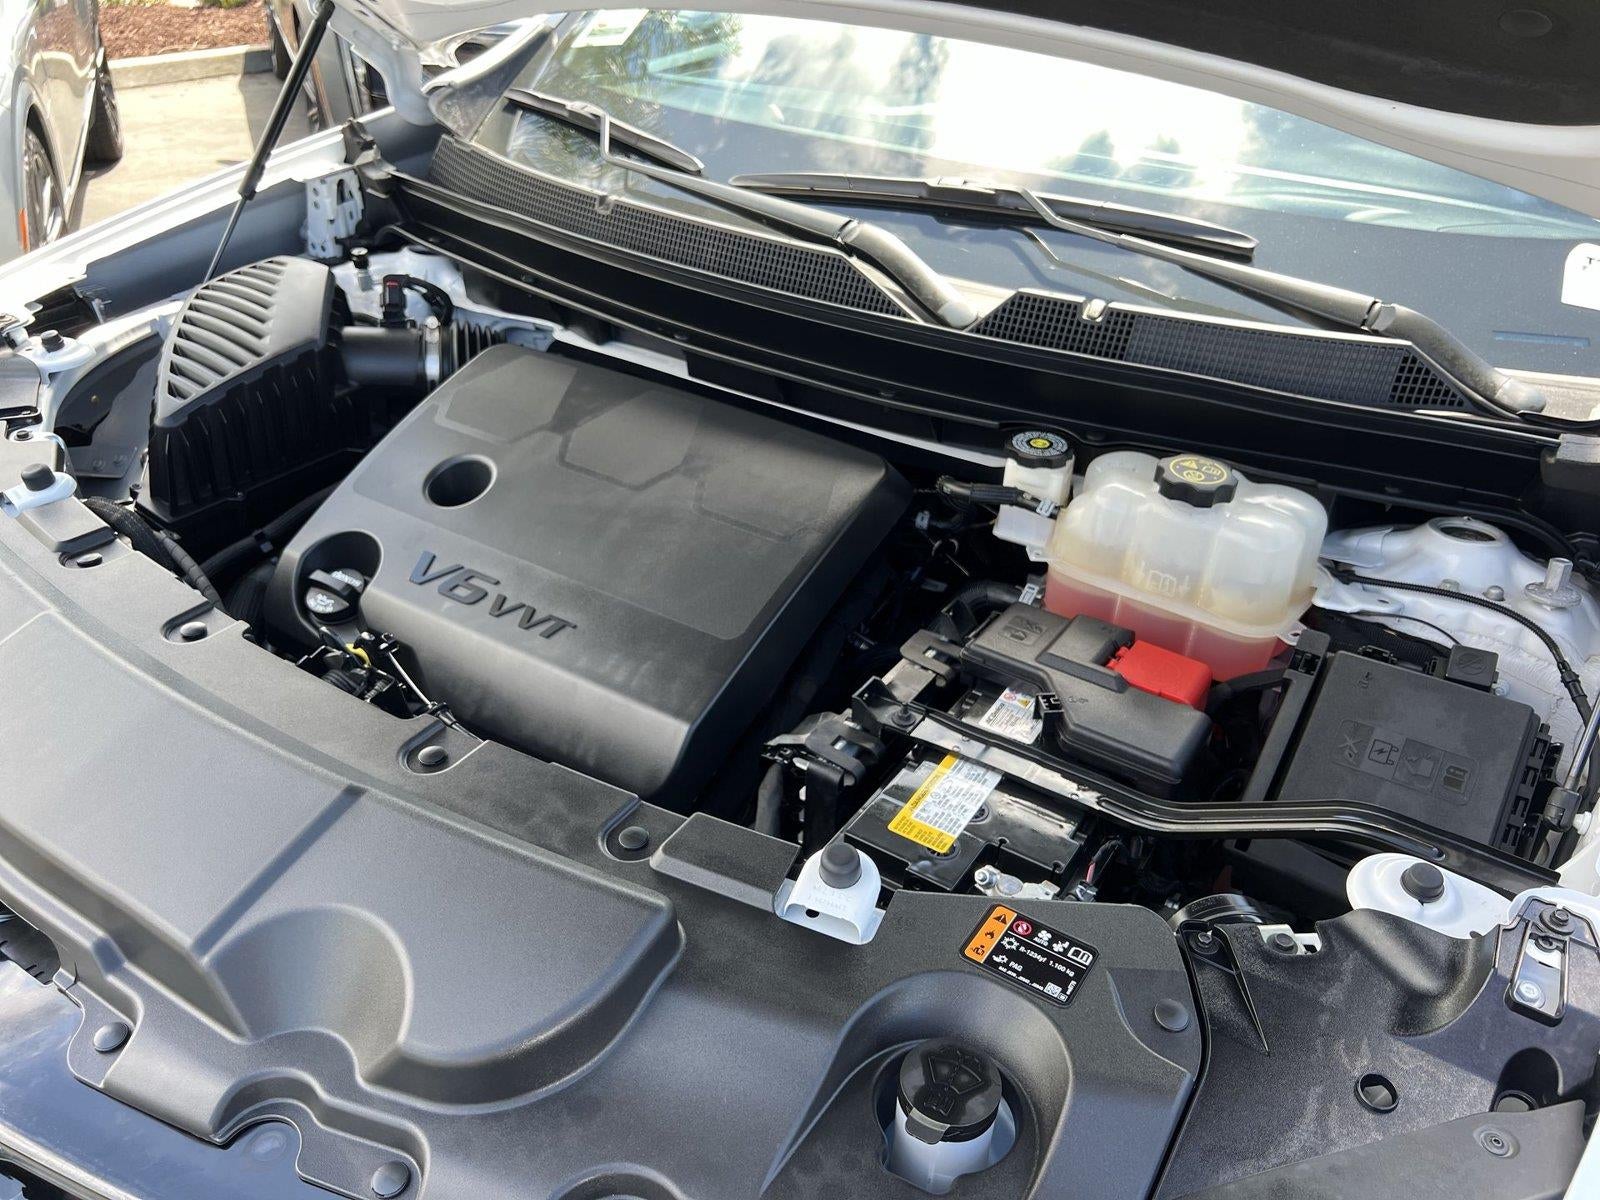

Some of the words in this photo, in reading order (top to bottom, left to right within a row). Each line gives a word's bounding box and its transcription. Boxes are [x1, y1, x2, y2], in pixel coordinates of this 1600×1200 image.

[409, 550, 500, 605] V6
[489, 593, 577, 639] VVT
[1033, 937, 1049, 947] AUTO
[1008, 961, 1023, 972] PAG
[1065, 969, 1075, 978] kg
